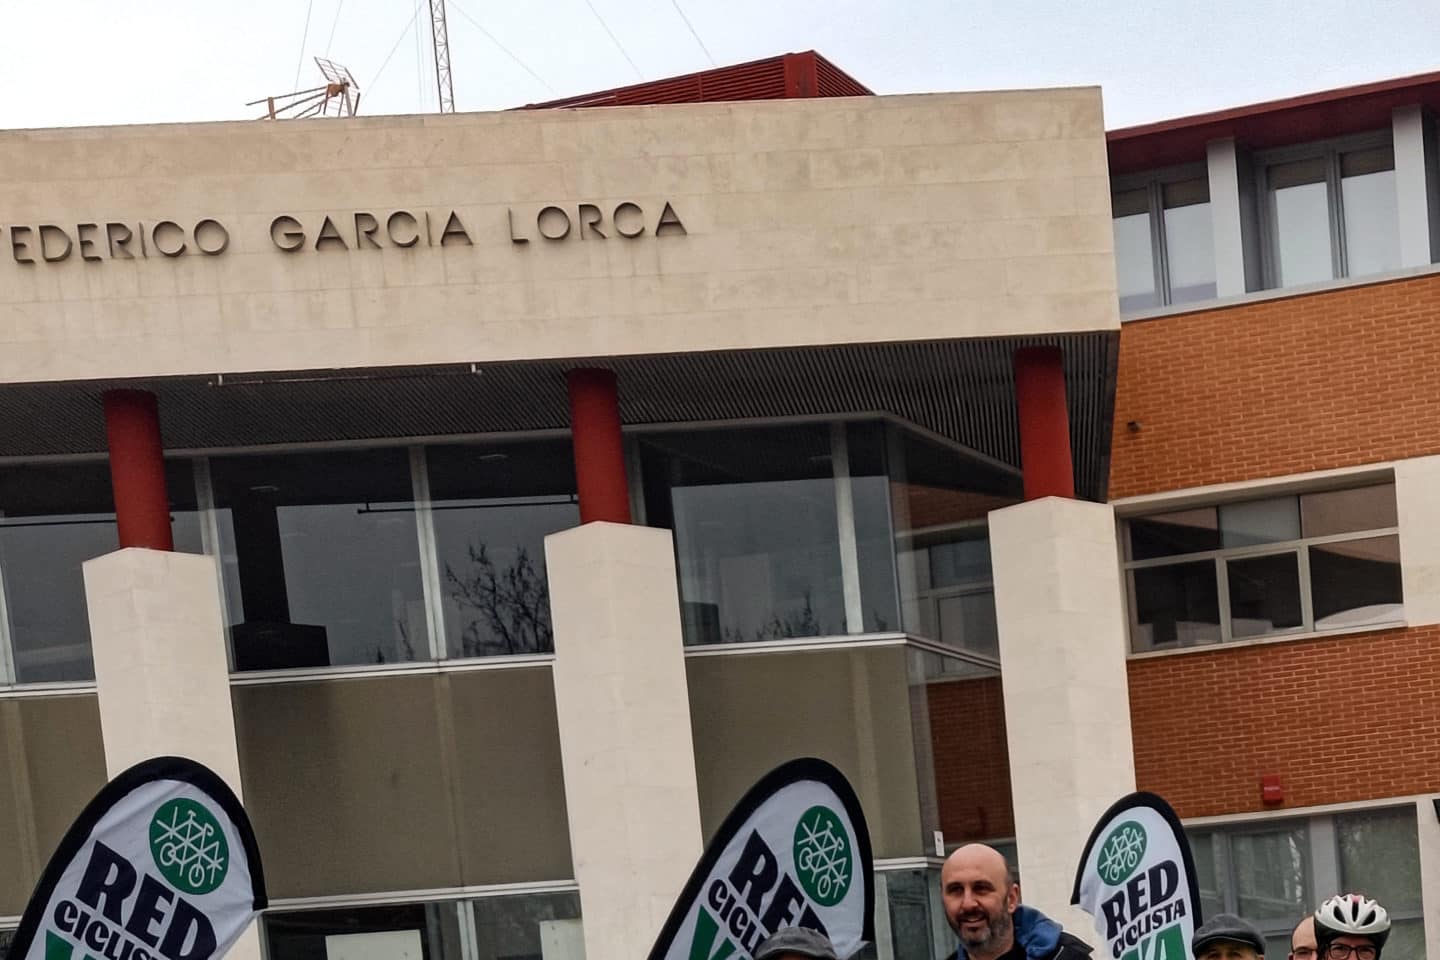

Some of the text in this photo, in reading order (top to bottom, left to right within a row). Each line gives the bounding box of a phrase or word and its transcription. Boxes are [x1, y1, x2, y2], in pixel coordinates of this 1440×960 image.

[0, 201, 688, 265] EDERICO GARCIA LORCA
[1101, 859, 1179, 941] RED
[1112, 898, 1187, 960] CICLISTA
